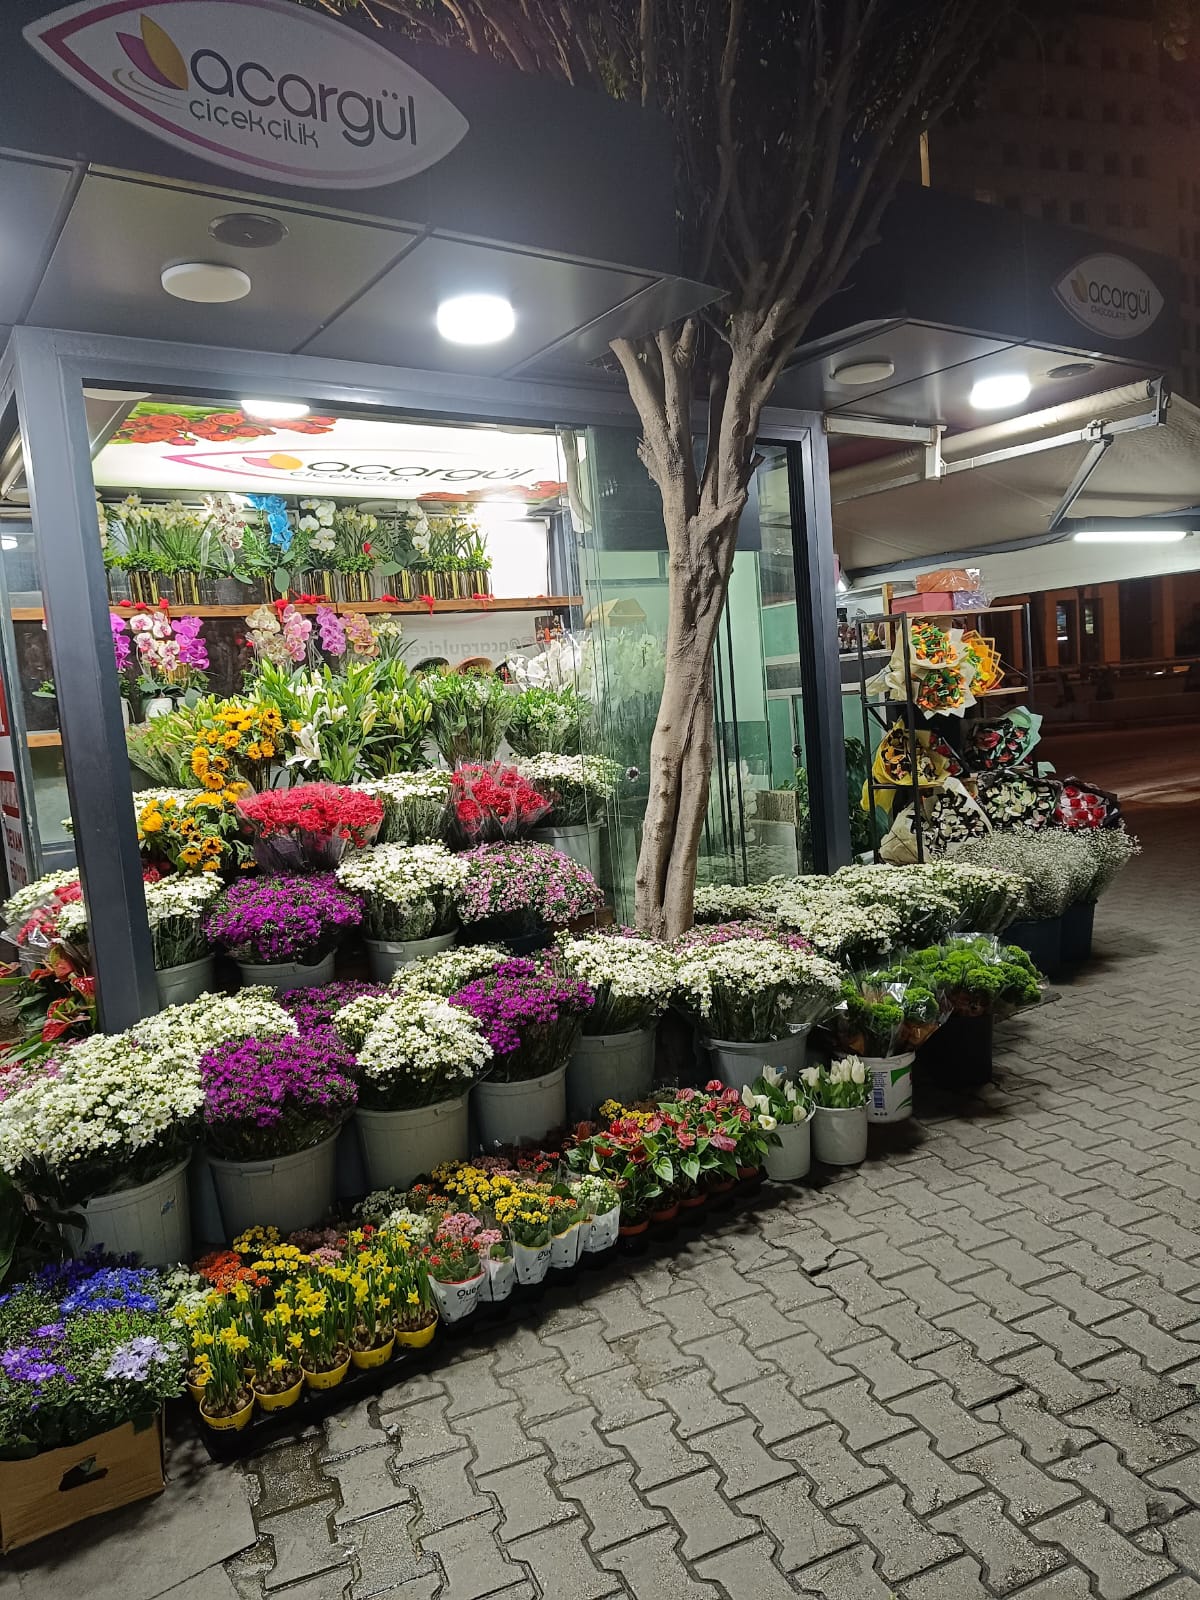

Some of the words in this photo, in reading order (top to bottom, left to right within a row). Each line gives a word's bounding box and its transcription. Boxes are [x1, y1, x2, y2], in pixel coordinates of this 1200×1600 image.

[190, 49, 417, 147] acargül
[190, 99, 319, 148] çiçekçilik
[1088, 281, 1151, 319] acargül
[306, 461, 535, 481] acargül
